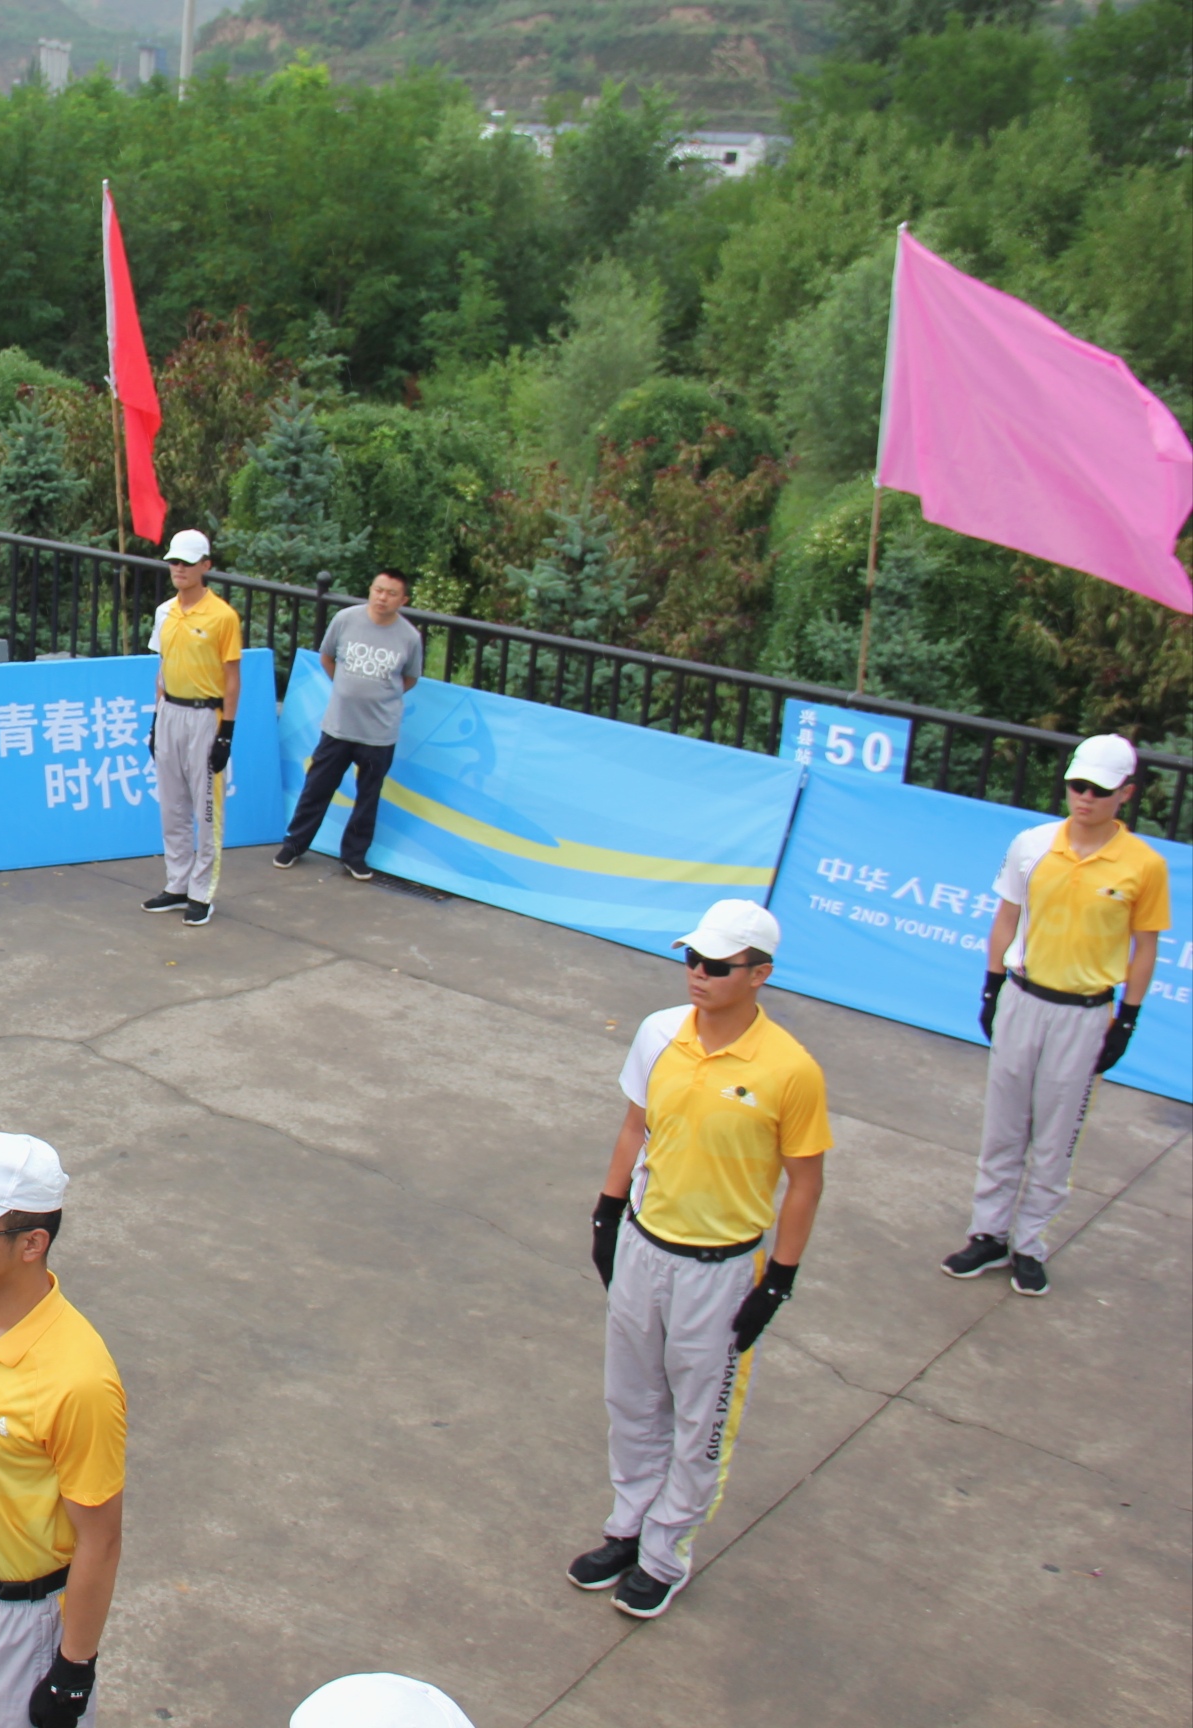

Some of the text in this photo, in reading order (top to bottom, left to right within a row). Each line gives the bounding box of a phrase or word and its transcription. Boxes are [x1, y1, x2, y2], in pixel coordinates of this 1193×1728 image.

[346, 641, 401, 670] KOLON
[794, 709, 817, 766] 兴县站
[824, 723, 894, 774] 50
[808, 894, 845, 917] THE
[848, 905, 890, 928] 2ND
[893, 915, 957, 945] YOUTH
[705, 1419, 724, 1461] 2019
